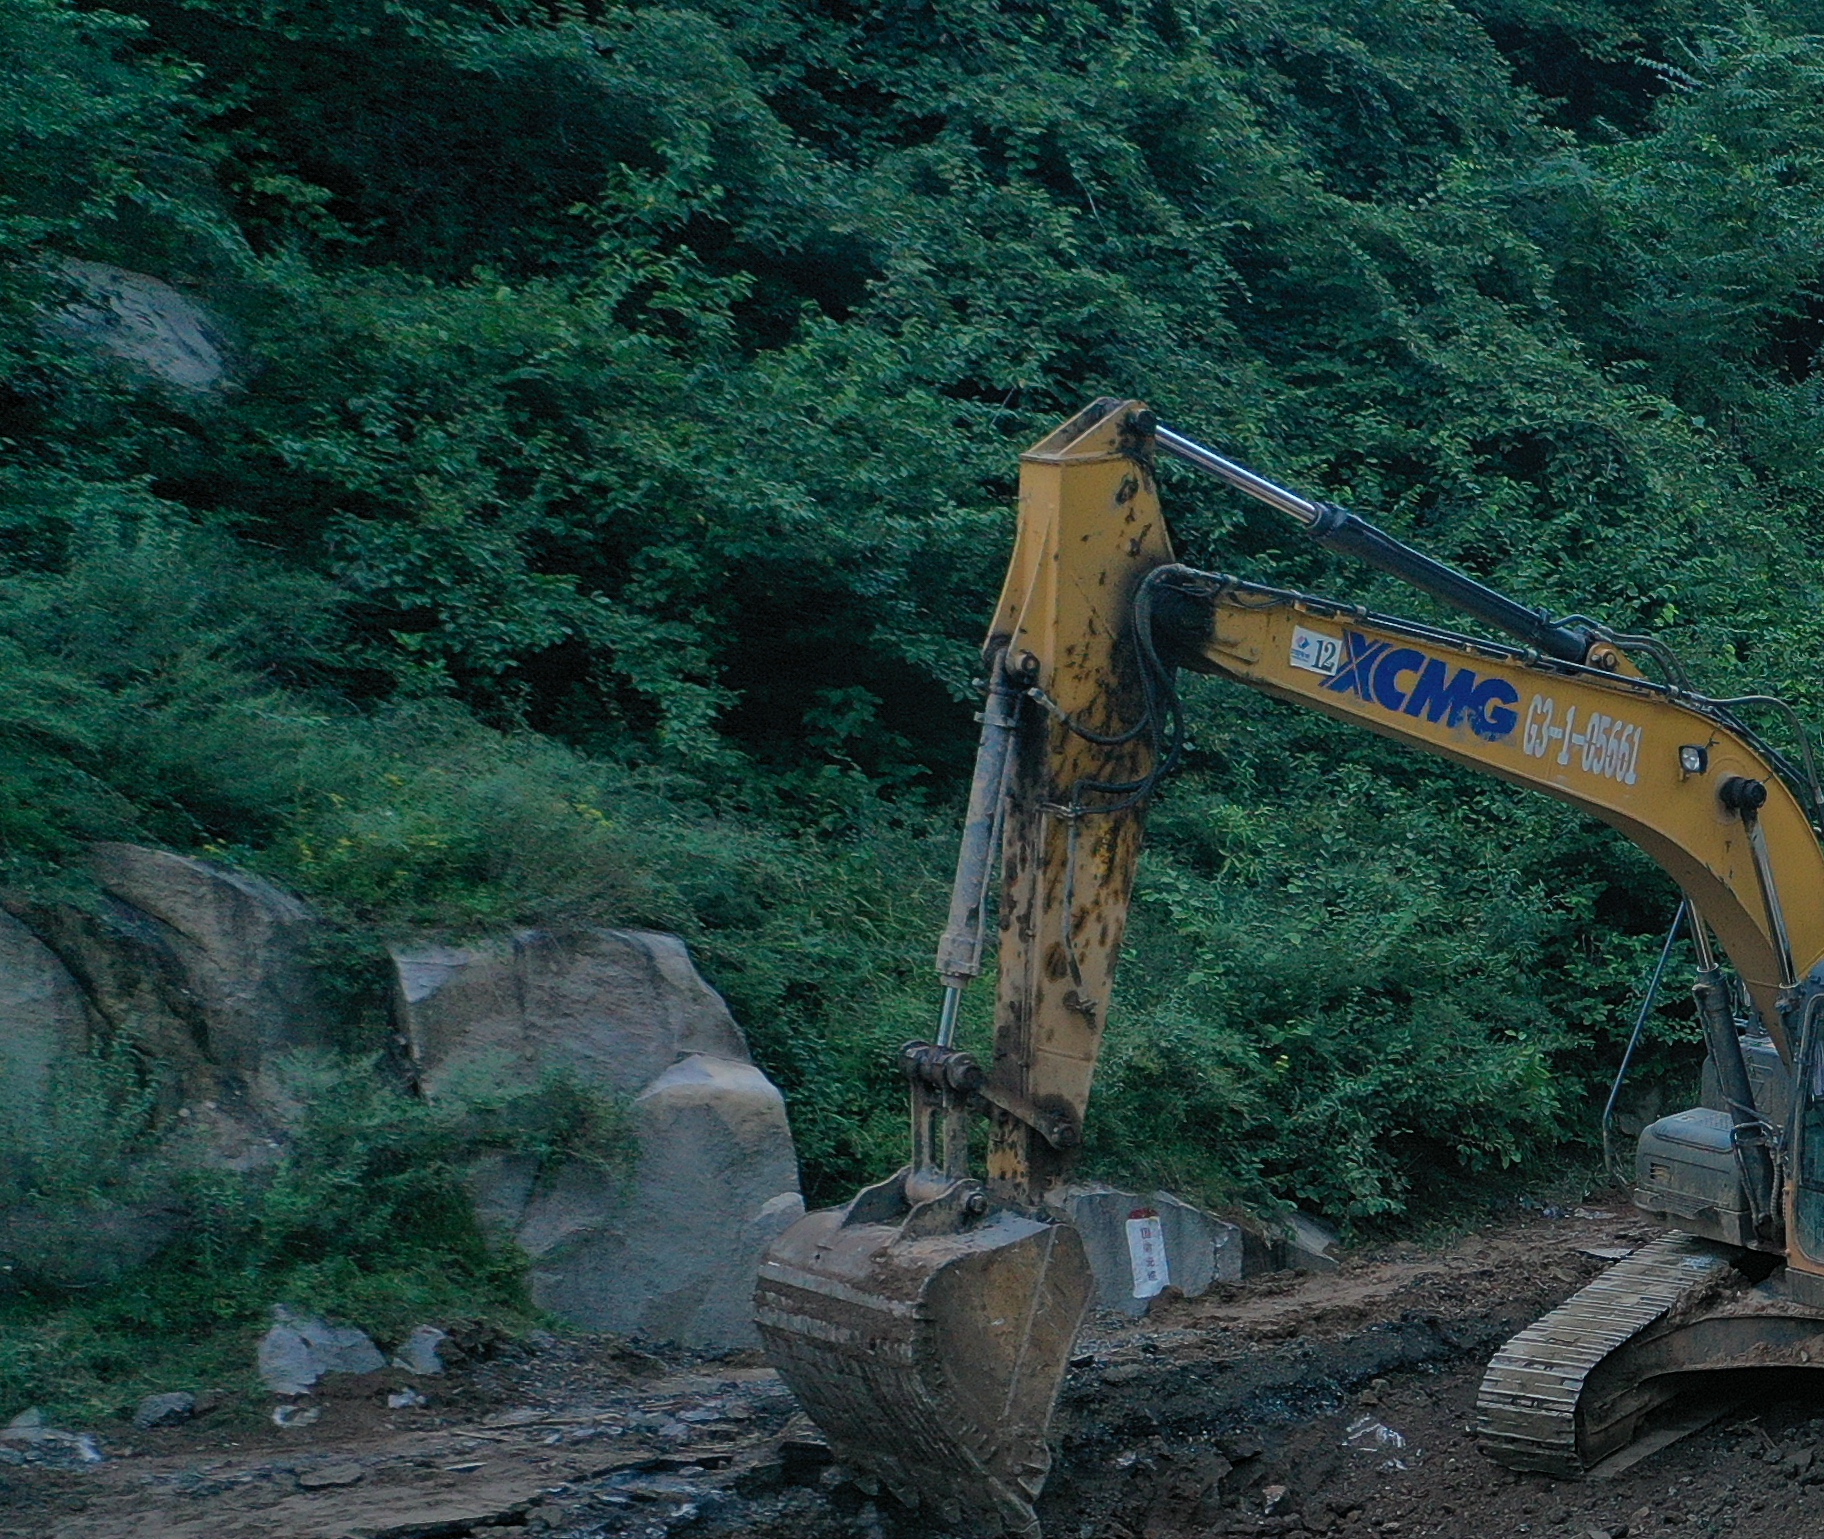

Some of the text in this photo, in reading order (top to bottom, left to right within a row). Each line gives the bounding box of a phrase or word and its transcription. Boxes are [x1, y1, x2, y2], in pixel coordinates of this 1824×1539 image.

[1311, 640, 1336, 673] 12
[1319, 629, 1520, 742] XCMG
[1523, 694, 1643, 785] G3-1-05661
